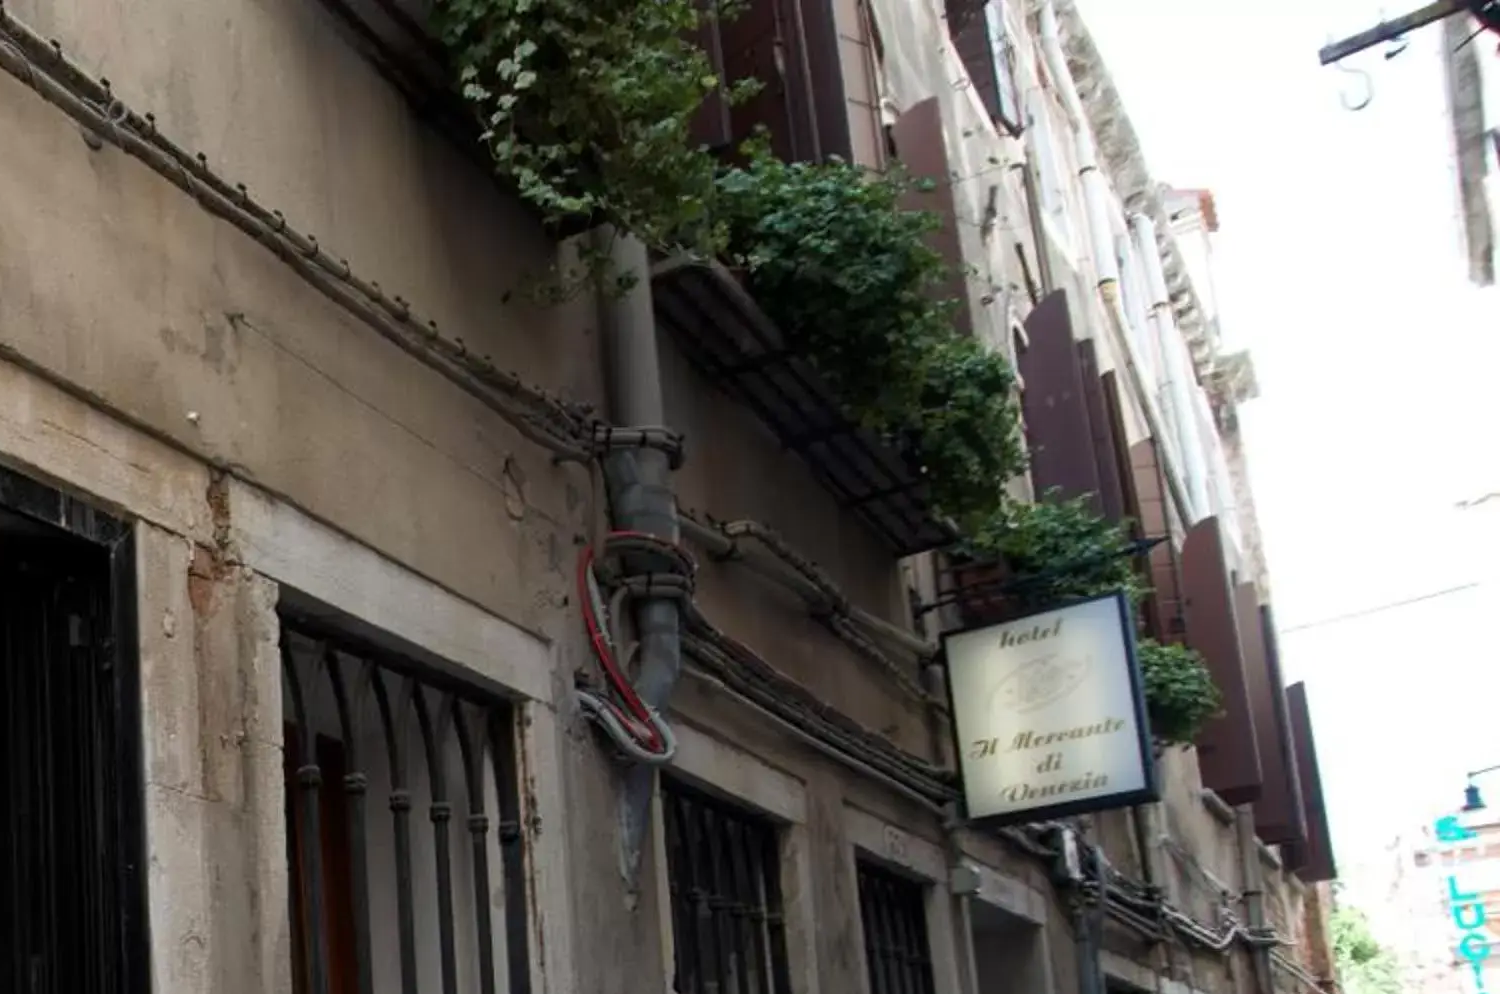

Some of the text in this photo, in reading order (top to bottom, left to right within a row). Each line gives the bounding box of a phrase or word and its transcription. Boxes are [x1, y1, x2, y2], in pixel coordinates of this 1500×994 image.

[1000, 617, 1063, 649] hotel
[970, 717, 1125, 760] Il Mercante
[1036, 752, 1063, 773] di
[1001, 772, 1108, 802] Venezia
